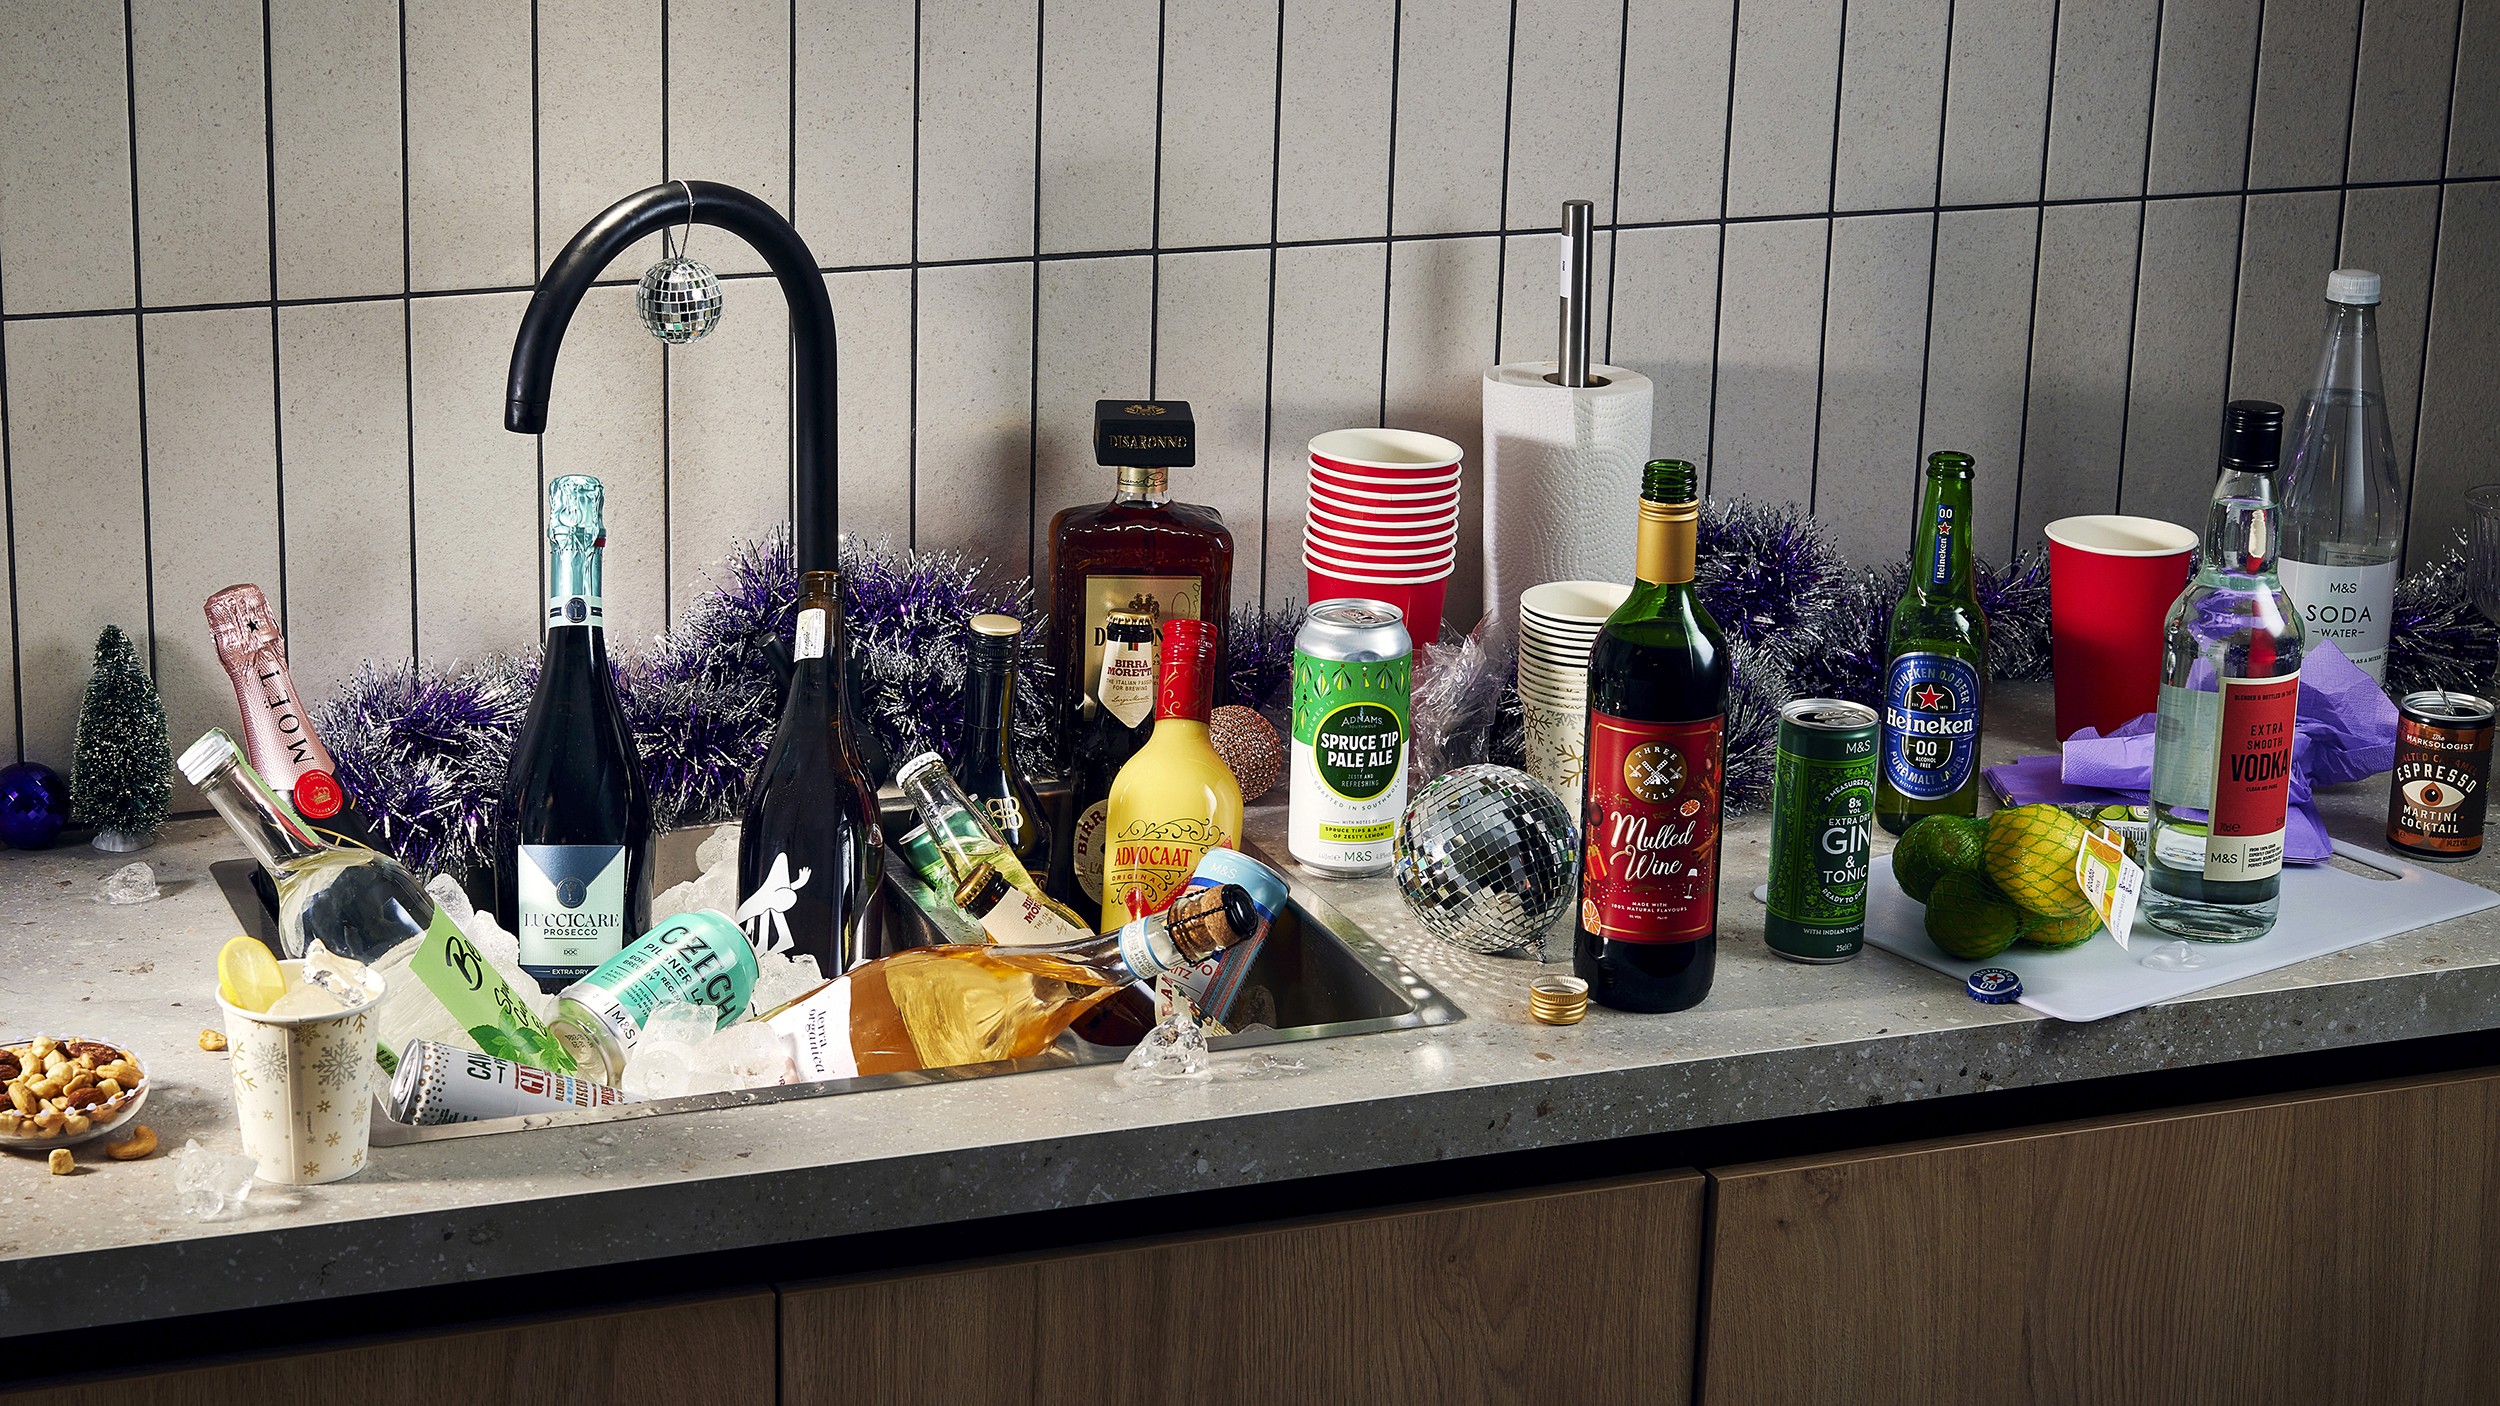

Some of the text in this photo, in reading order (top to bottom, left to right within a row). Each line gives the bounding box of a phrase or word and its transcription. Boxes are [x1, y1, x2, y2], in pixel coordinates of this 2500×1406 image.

[1109, 434, 1187, 449] DISARONNO
[1939, 509, 1952, 519] 0.0
[1937, 538, 1947, 578] Heineken
[2330, 582, 2357, 593] M&S
[2306, 605, 2372, 624] SODA
[2321, 628, 2358, 638] WATER
[1115, 660, 1148, 668] BIRRA
[1893, 668, 1970, 704] HEINEKEN 0.0 BEER
[1341, 716, 1383, 727] ADNAMS
[1886, 706, 1973, 735] Heineken
[2251, 722, 2283, 736] EXTRA
[1320, 731, 1399, 751] SPRUCE TIP
[1846, 739, 1871, 754] M&S
[2247, 737, 2282, 750] SMOOTH
[2406, 734, 2474, 750] MARKSOLOGIST
[1327, 750, 1393, 768] PALE ALE
[1635, 746, 1677, 760] THREE
[1890, 751, 1964, 785] PURE MALT LAGER
[2231, 748, 2288, 782] VODKA
[2397, 762, 2477, 794] ESPRESSO
[1314, 781, 1344, 808] CRAFTED
[1362, 778, 1400, 811] SOUTHWOLD
[1635, 786, 1675, 800] MILLS
[1830, 779, 1864, 797] MEASURES
[1848, 798, 1862, 808] 8%
[1829, 812, 1871, 826] EXTRA DRY
[2403, 804, 2457, 822] MARTINI
[1078, 810, 1106, 856] BIRR
[1610, 811, 1696, 852] Mulled
[2401, 816, 2459, 834] COCKTAIL
[1822, 820, 1871, 855] GIN
[1114, 846, 1192, 867] ADVOCAAT
[1344, 850, 1372, 861] M&S
[1609, 844, 1683, 882] Wine
[1845, 855, 1855, 868] &
[2211, 853, 2238, 864] M&S
[1210, 863, 1238, 880] M&S
[1823, 865, 1867, 883] TONIC
[1111, 874, 1162, 890] ORIGINAL
[1822, 888, 1844, 903] READY
[524, 913, 620, 928] LUCCICARE
[1846, 925, 1859, 933] TONIC
[643, 943, 693, 985] PILSNER
[659, 925, 737, 1022] CZECH
[1980, 982, 1997, 990] 0.0
[611, 1010, 635, 1039] M&S
[805, 1009, 825, 1073] organica
